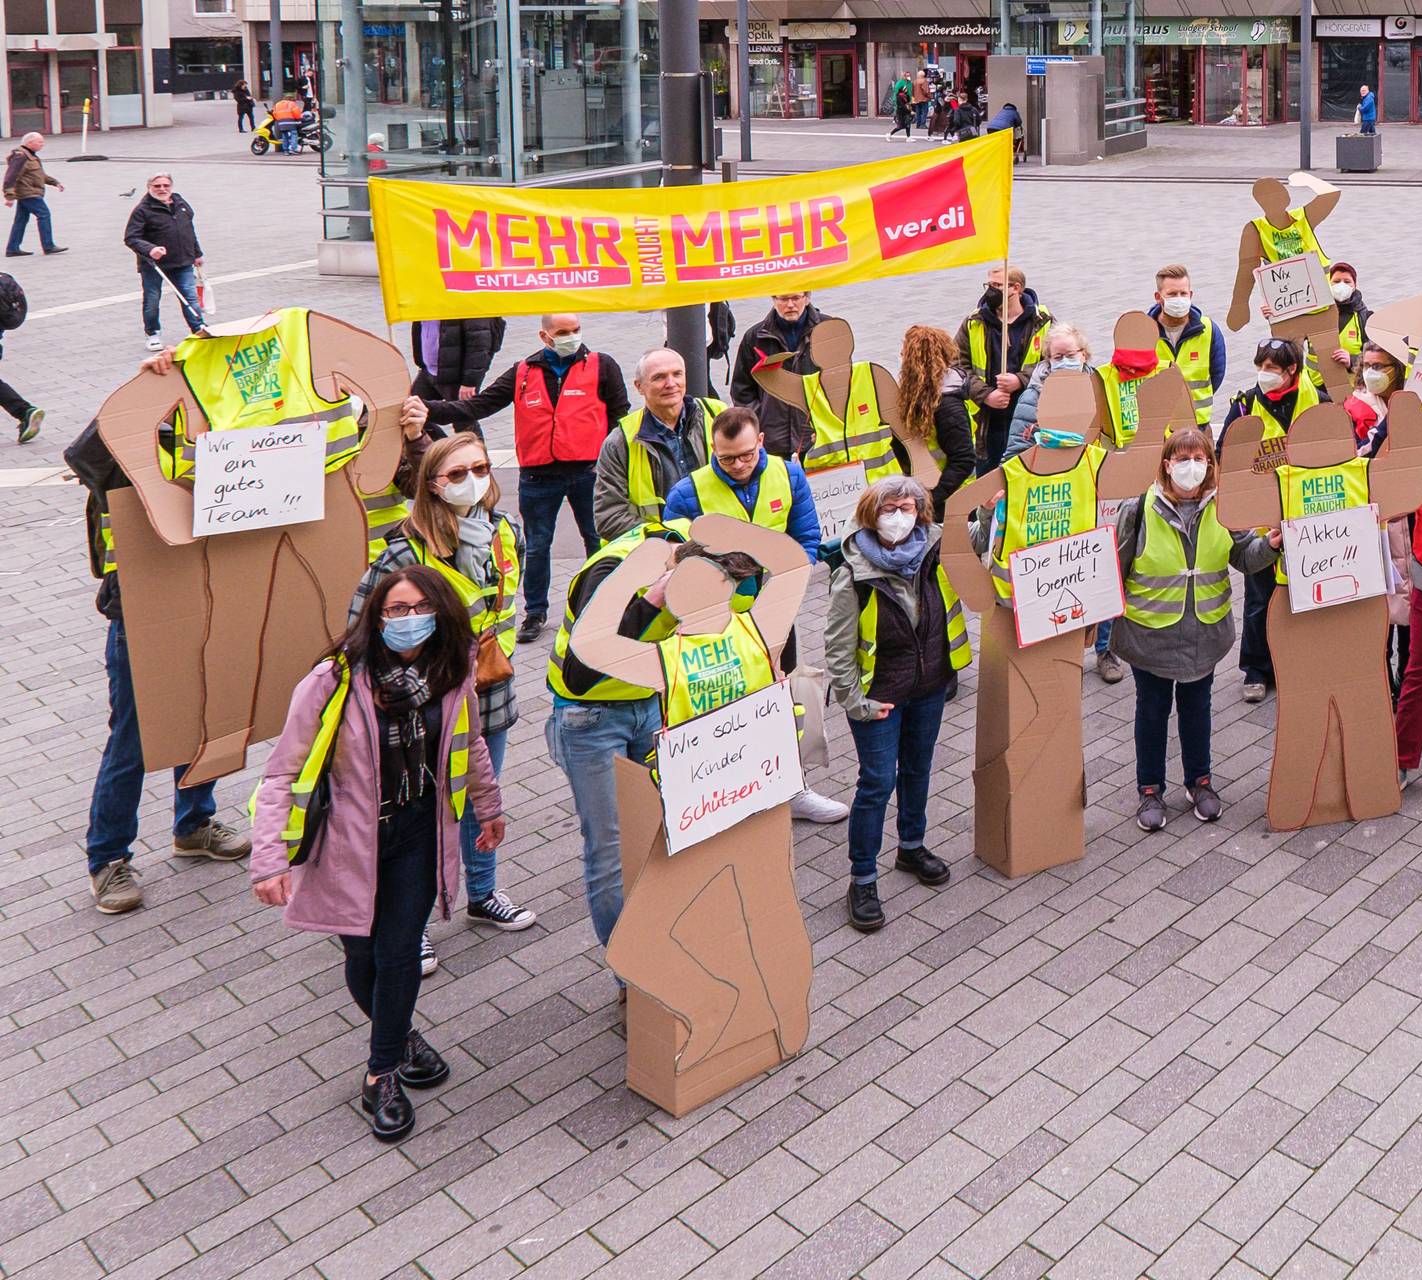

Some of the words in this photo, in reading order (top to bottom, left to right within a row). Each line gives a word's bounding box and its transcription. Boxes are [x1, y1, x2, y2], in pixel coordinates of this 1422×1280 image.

[918, 24, 1000, 36] Stöberstübchen
[671, 195, 848, 264] MEHR
[884, 206, 966, 242] ver.di
[433, 207, 629, 269] MEHR
[640, 216, 667, 286] BRAUCHT
[474, 270, 600, 288] ENTLASTUNG
[719, 256, 809, 278] PERSONAL
[1271, 266, 1291, 282] Nix
[225, 336, 281, 371] MEHR
[208, 437, 233, 453] Wir
[251, 431, 303, 449] wären
[224, 457, 257, 473] ein
[214, 476, 265, 504] gutes
[1027, 482, 1072, 505] MEHR
[1302, 475, 1345, 497] MEHR
[201, 502, 269, 523] Team
[1026, 507, 1073, 523] BRAUCHT
[1303, 499, 1347, 515] BRAUCHT
[1026, 520, 1071, 542] MEHR
[1298, 522, 1350, 547] Akku
[1018, 556, 1050, 577] Die
[1057, 539, 1102, 567] Hütte
[1036, 571, 1087, 598] brennt
[687, 664, 744, 697] BRAUCHT
[690, 680, 747, 715] MEHR
[668, 732, 700, 759] Wie
[712, 712, 748, 739] soll
[755, 699, 781, 721] ich
[690, 744, 747, 784] Kinder
